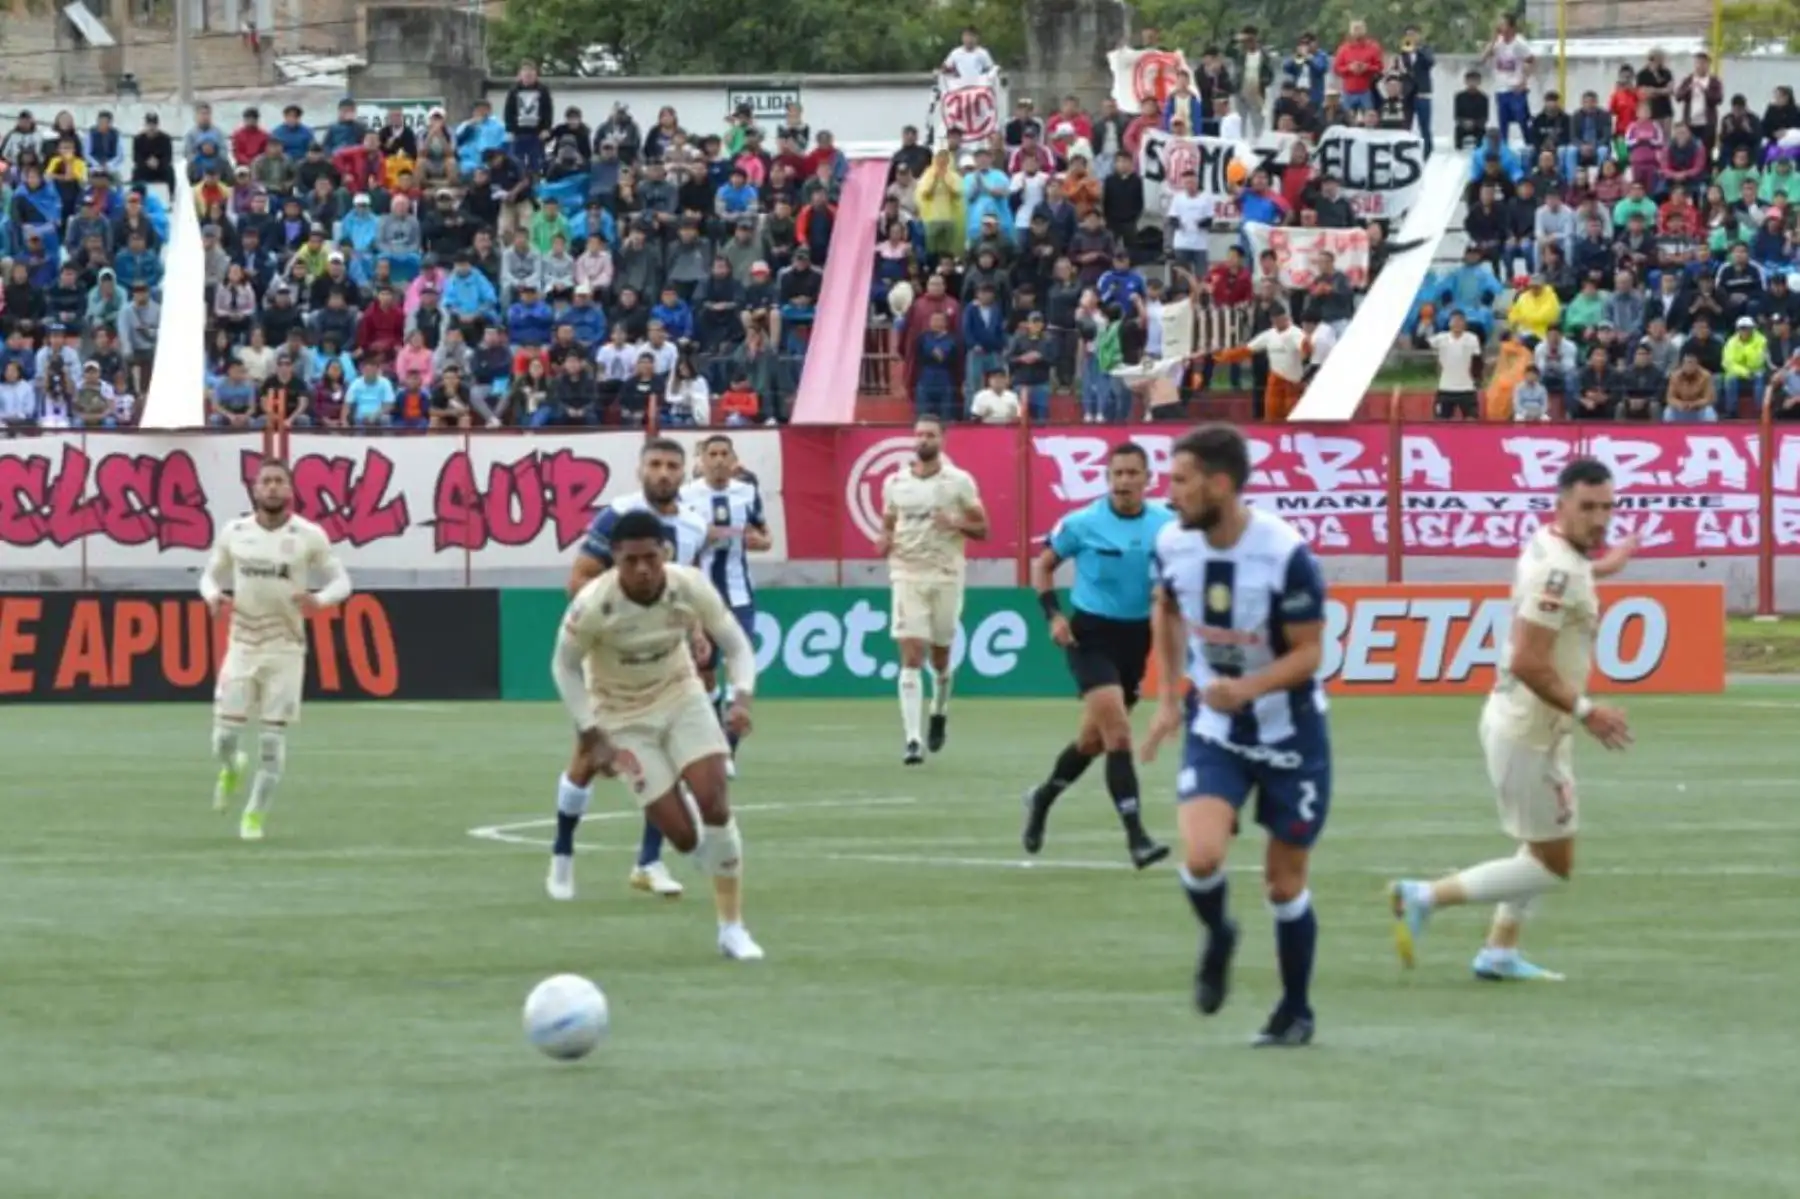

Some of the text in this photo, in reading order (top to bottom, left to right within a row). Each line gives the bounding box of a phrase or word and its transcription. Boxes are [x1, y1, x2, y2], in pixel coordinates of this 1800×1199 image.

[240, 447, 409, 548] EL
[434, 447, 610, 552] SUR
[1484, 496, 1510, 509] Y
[1528, 496, 1723, 509] SMPRE
[53, 594, 398, 697] APUTO
